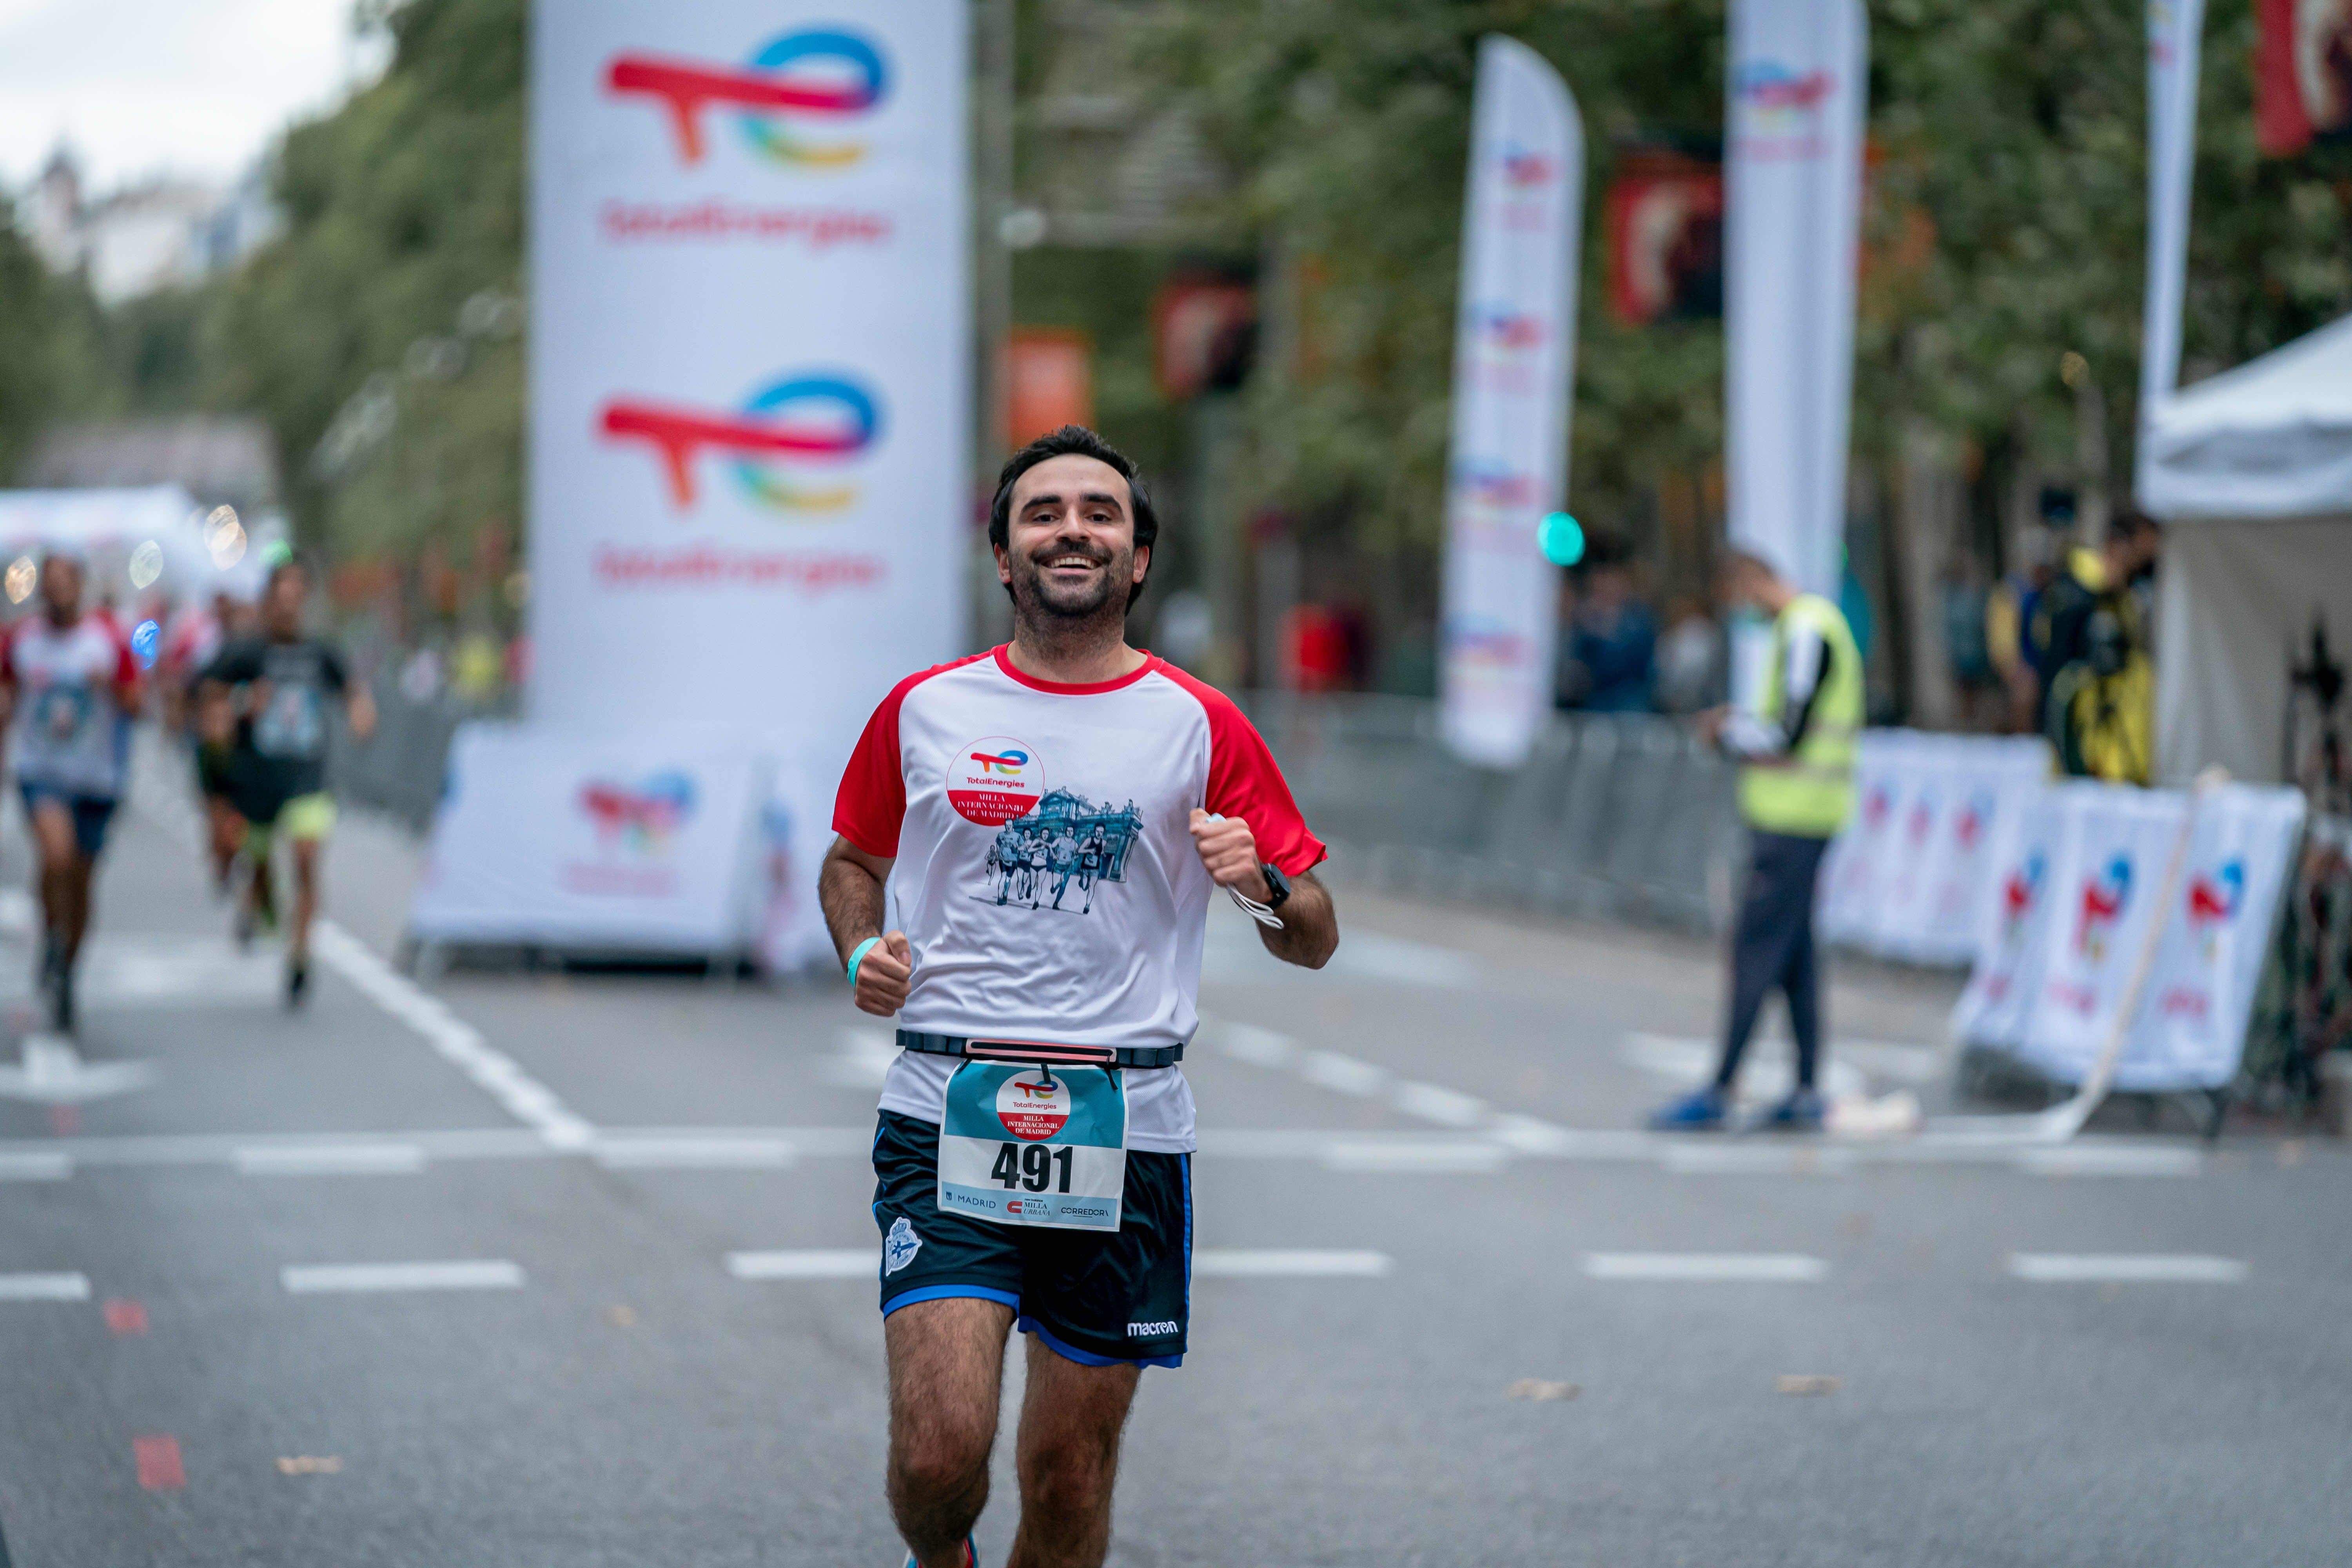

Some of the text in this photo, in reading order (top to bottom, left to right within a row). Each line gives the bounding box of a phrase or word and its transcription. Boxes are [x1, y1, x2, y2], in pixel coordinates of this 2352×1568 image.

[967, 777, 1025, 788] TotalEnergies
[979, 793, 1005, 802] MILLA
[981, 810, 1014, 819] MADRID
[1013, 1102, 1057, 1110] TotalEnergies
[991, 1142, 1073, 1194] 491
[958, 1195, 996, 1209] MADRID
[1127, 1321, 1178, 1337] macron
